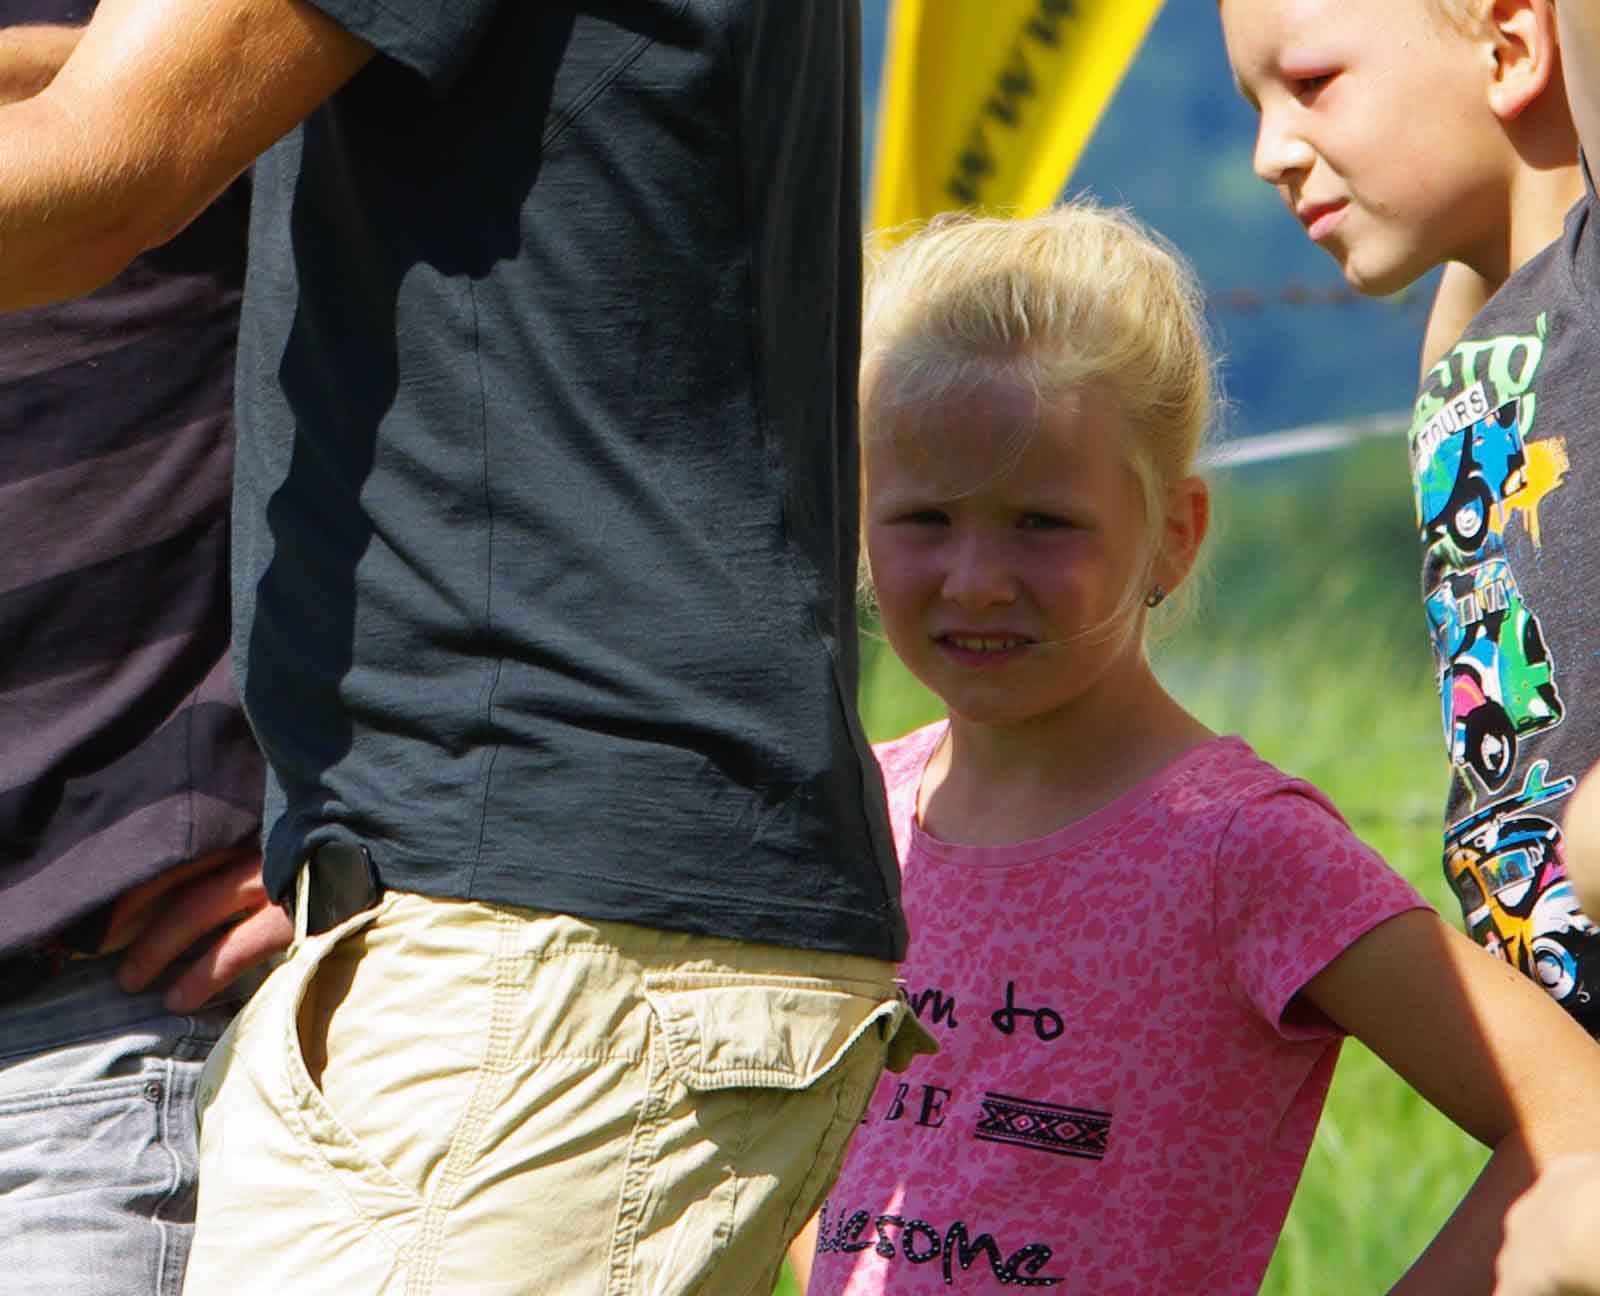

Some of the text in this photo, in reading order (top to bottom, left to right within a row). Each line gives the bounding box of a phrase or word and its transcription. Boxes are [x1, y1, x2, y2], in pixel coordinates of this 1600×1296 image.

[898, 980, 1064, 1041] rn to
[884, 1083, 952, 1129] BE
[817, 1200, 1065, 1287] wesome
